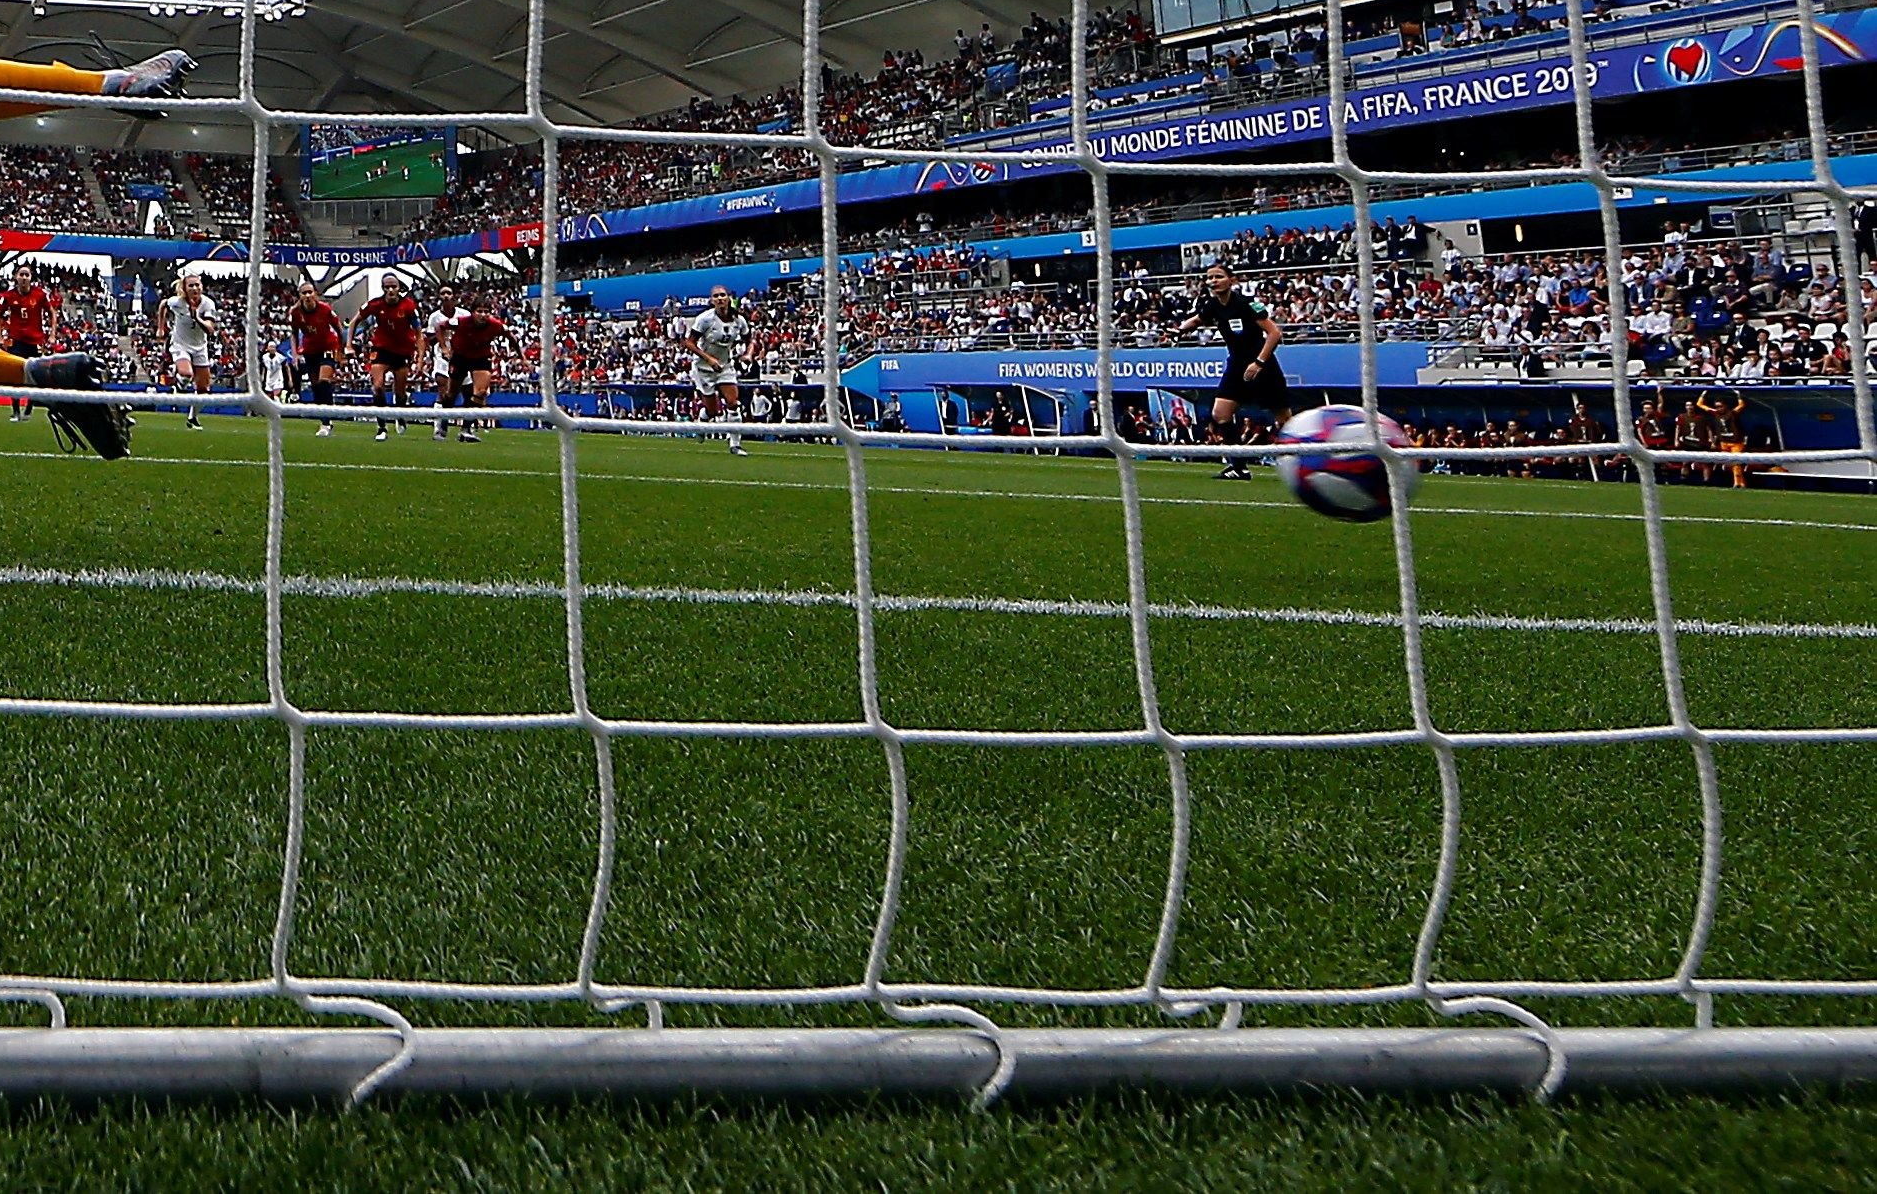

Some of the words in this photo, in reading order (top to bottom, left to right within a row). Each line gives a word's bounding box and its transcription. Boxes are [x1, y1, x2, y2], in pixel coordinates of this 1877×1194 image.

[1111, 127, 1182, 155] MONDE
[1185, 112, 1288, 146] FÉMININE
[1291, 106, 1324, 132] DE
[1362, 91, 1419, 120] FIFA,
[1423, 72, 1530, 110] FRANCE
[297, 251, 330, 263] DARE
[332, 252, 350, 263] TO
[353, 251, 387, 264] SHINE
[881, 359, 899, 371] FIFA
[998, 363, 1022, 378] FIFA
[1024, 362, 1083, 379] WOMEN'S
[1135, 362, 1165, 377] CUP
[1167, 362, 1223, 378] FRANCE
